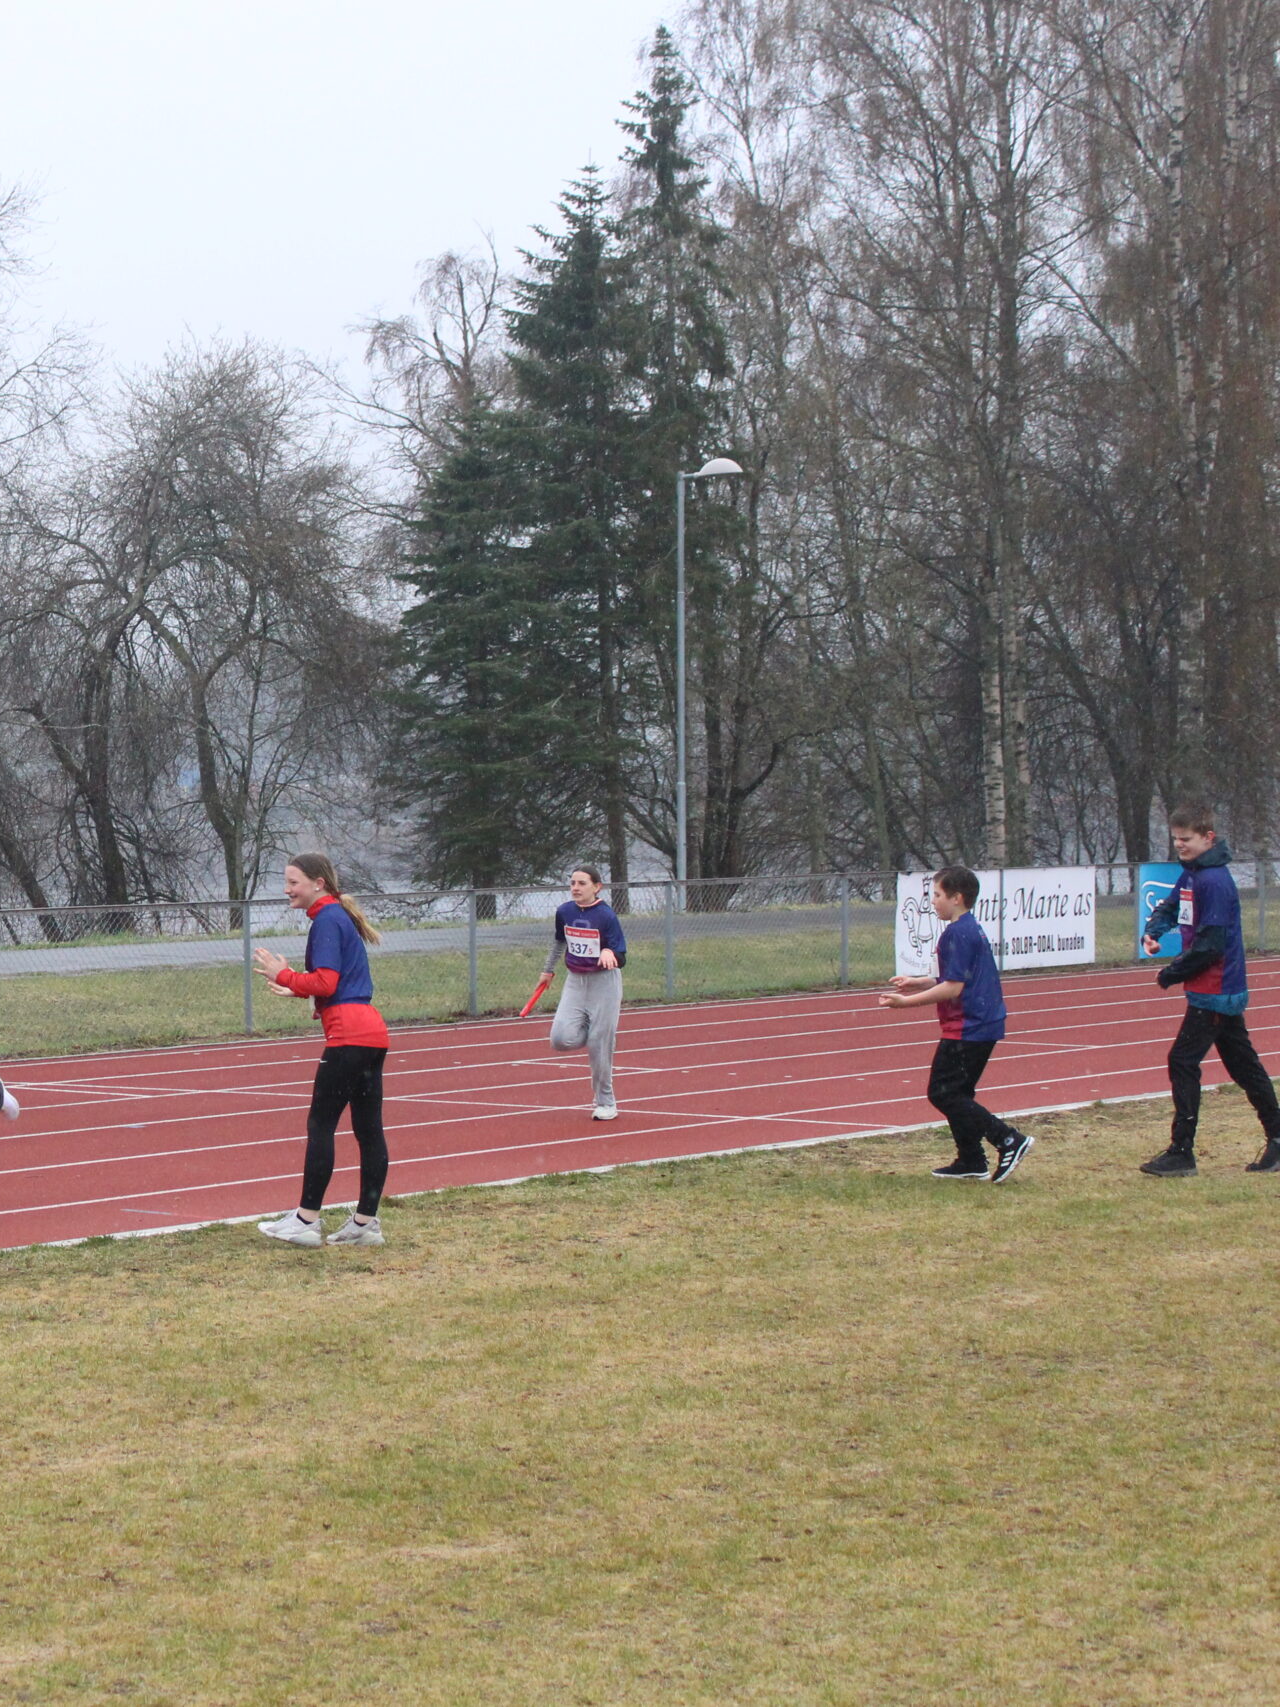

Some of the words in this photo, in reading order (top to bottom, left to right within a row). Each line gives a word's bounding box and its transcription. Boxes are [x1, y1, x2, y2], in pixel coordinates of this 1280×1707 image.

[1013, 883, 1069, 922] Marie
[1073, 891, 1092, 916] as
[570, 942, 588, 954] 537
[1057, 932, 1085, 951] bunaden
